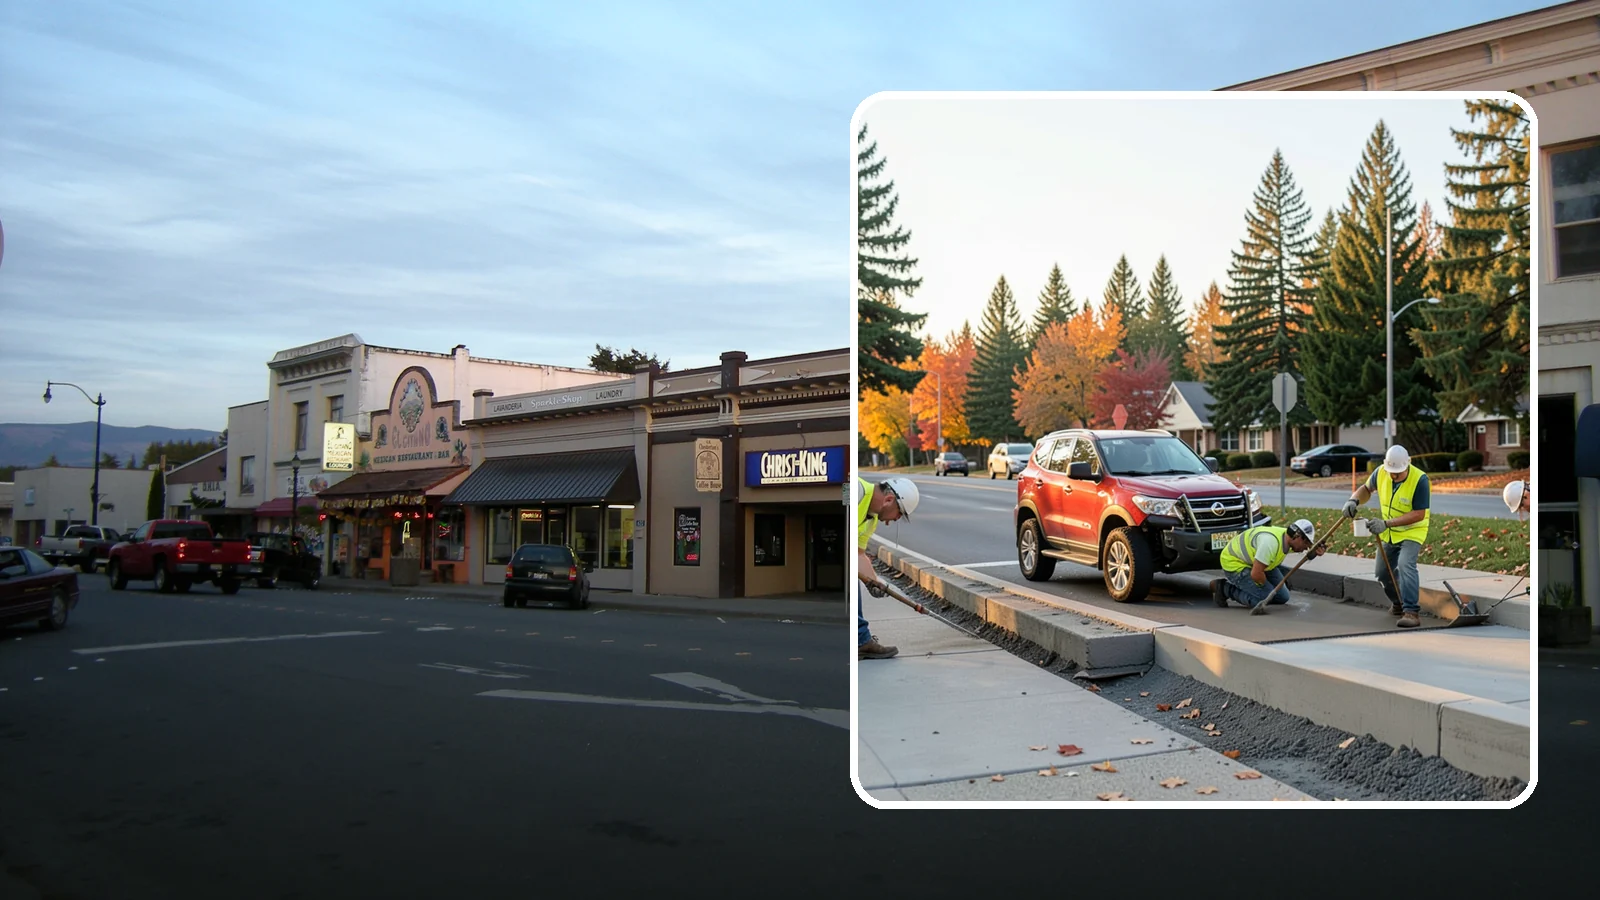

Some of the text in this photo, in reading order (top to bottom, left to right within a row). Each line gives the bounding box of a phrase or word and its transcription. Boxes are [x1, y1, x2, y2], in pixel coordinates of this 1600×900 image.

[494, 402, 522, 413] LAVANDERIA
[596, 389, 623, 400] LAUNDRY
[374, 455, 395, 463] MEXICAN
[398, 451, 434, 462] RESTAURANT
[438, 450, 450, 459] BAR
[761, 450, 827, 478] CHRIST KING
[696, 480, 722, 489] Coffee House
